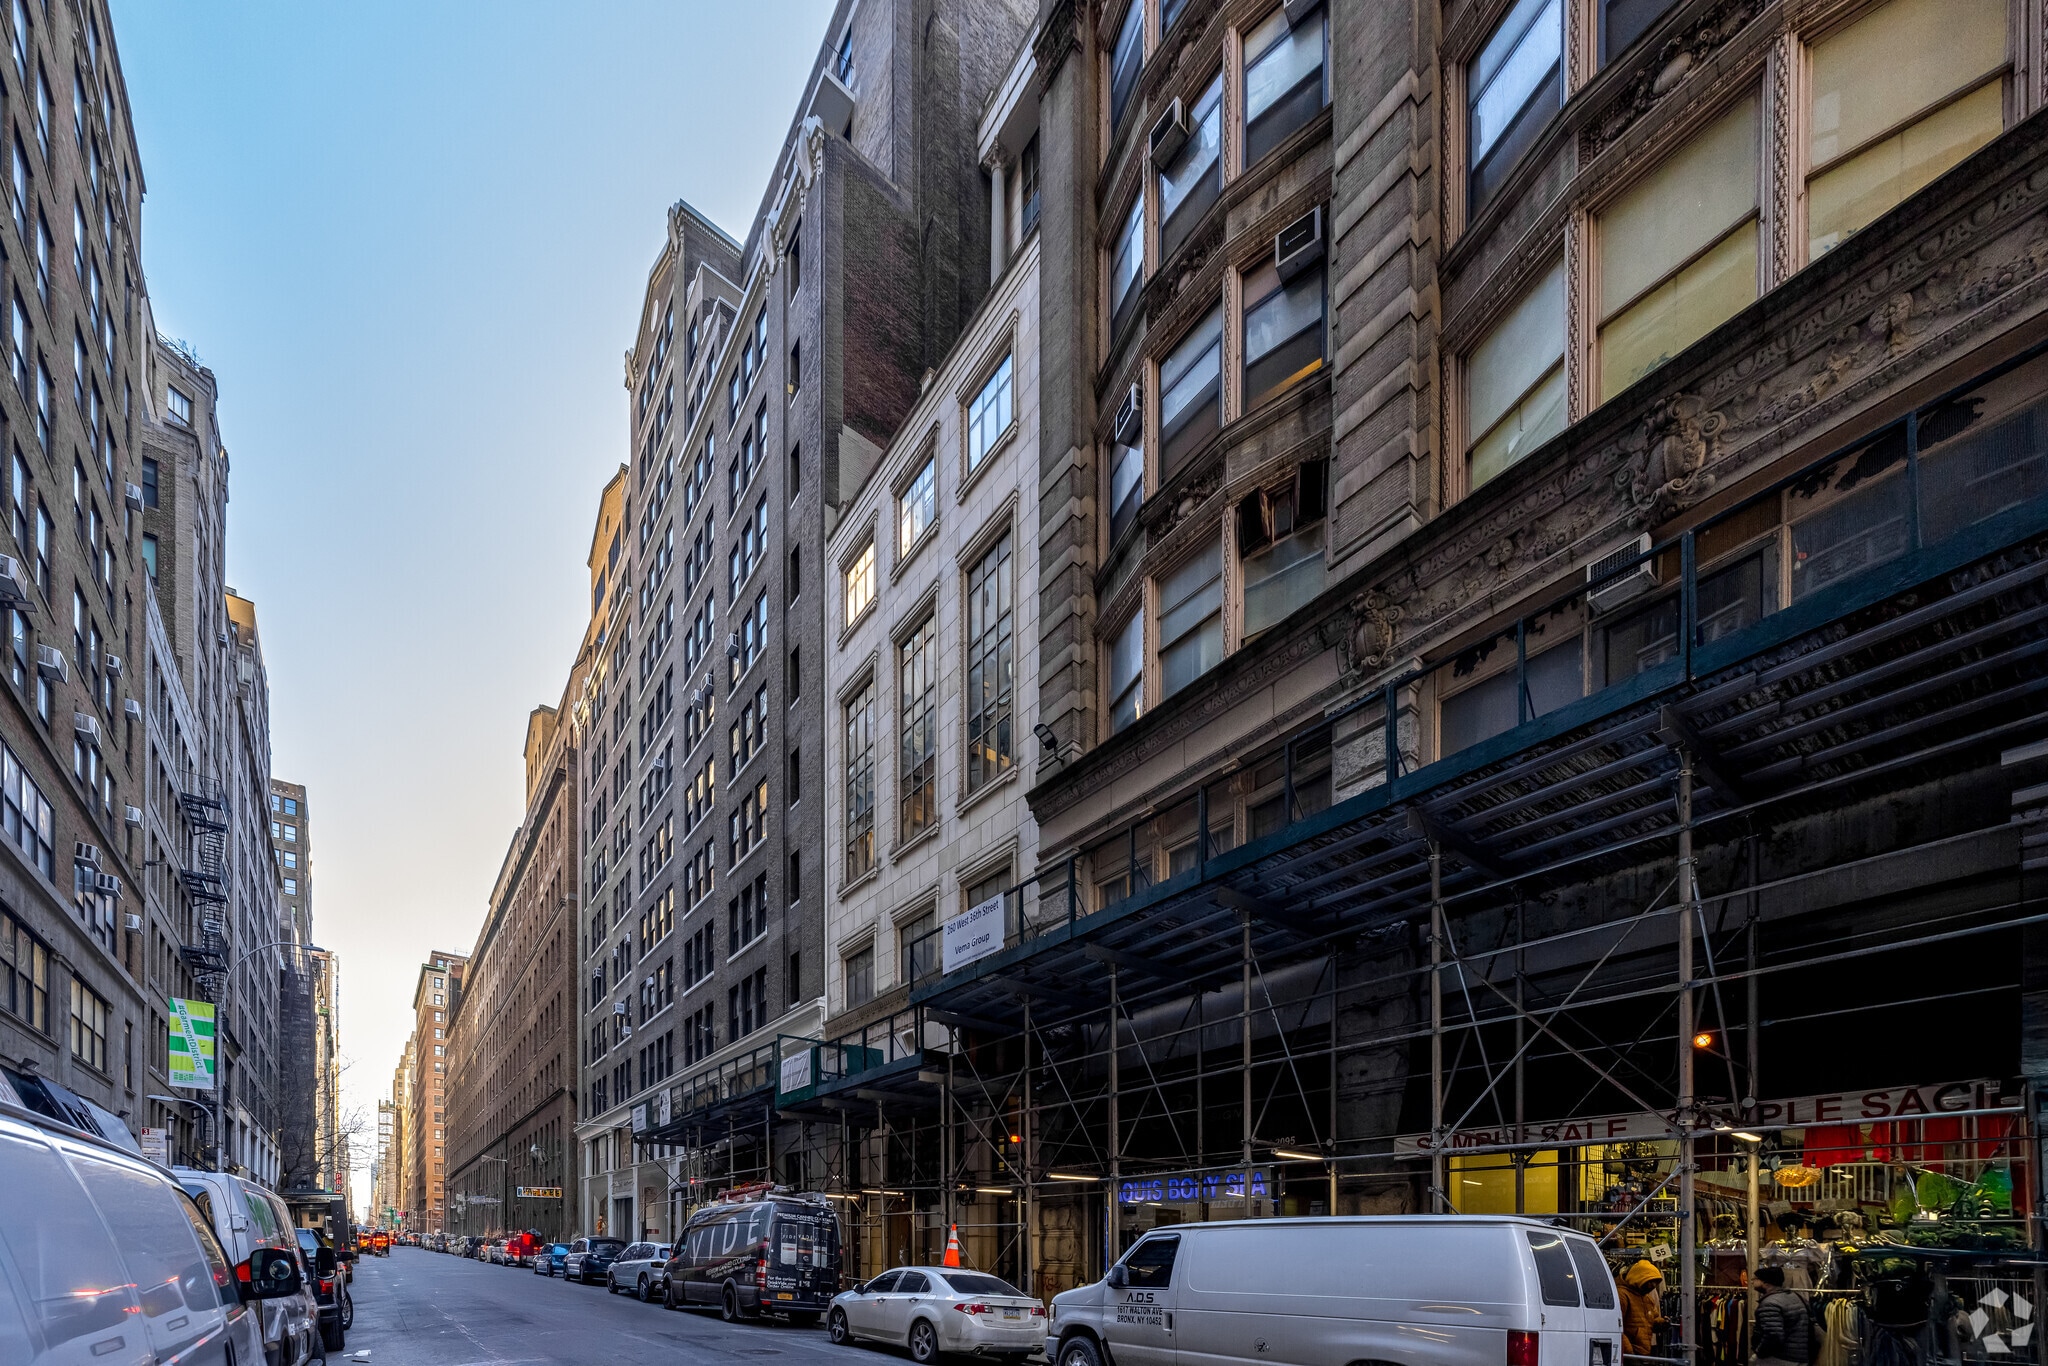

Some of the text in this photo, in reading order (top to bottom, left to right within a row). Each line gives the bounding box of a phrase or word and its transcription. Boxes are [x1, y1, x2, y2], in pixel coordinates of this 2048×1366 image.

[947, 900, 999, 935] 260 West 36th Street
[971, 933, 990, 947] Group
[178, 1004, 204, 1069] #GarmentDistrict
[1417, 1128, 1529, 1150] SMPLE
[1118, 1180, 1163, 1202] QUIS
[692, 1205, 763, 1267] VIDE
[1655, 1248, 1667, 1257] $5
[1117, 1306, 1163, 1316] 1617 WALTON AVE
[1137, 1316, 1145, 1324] NY
[1146, 1317, 1162, 1326] 10452
